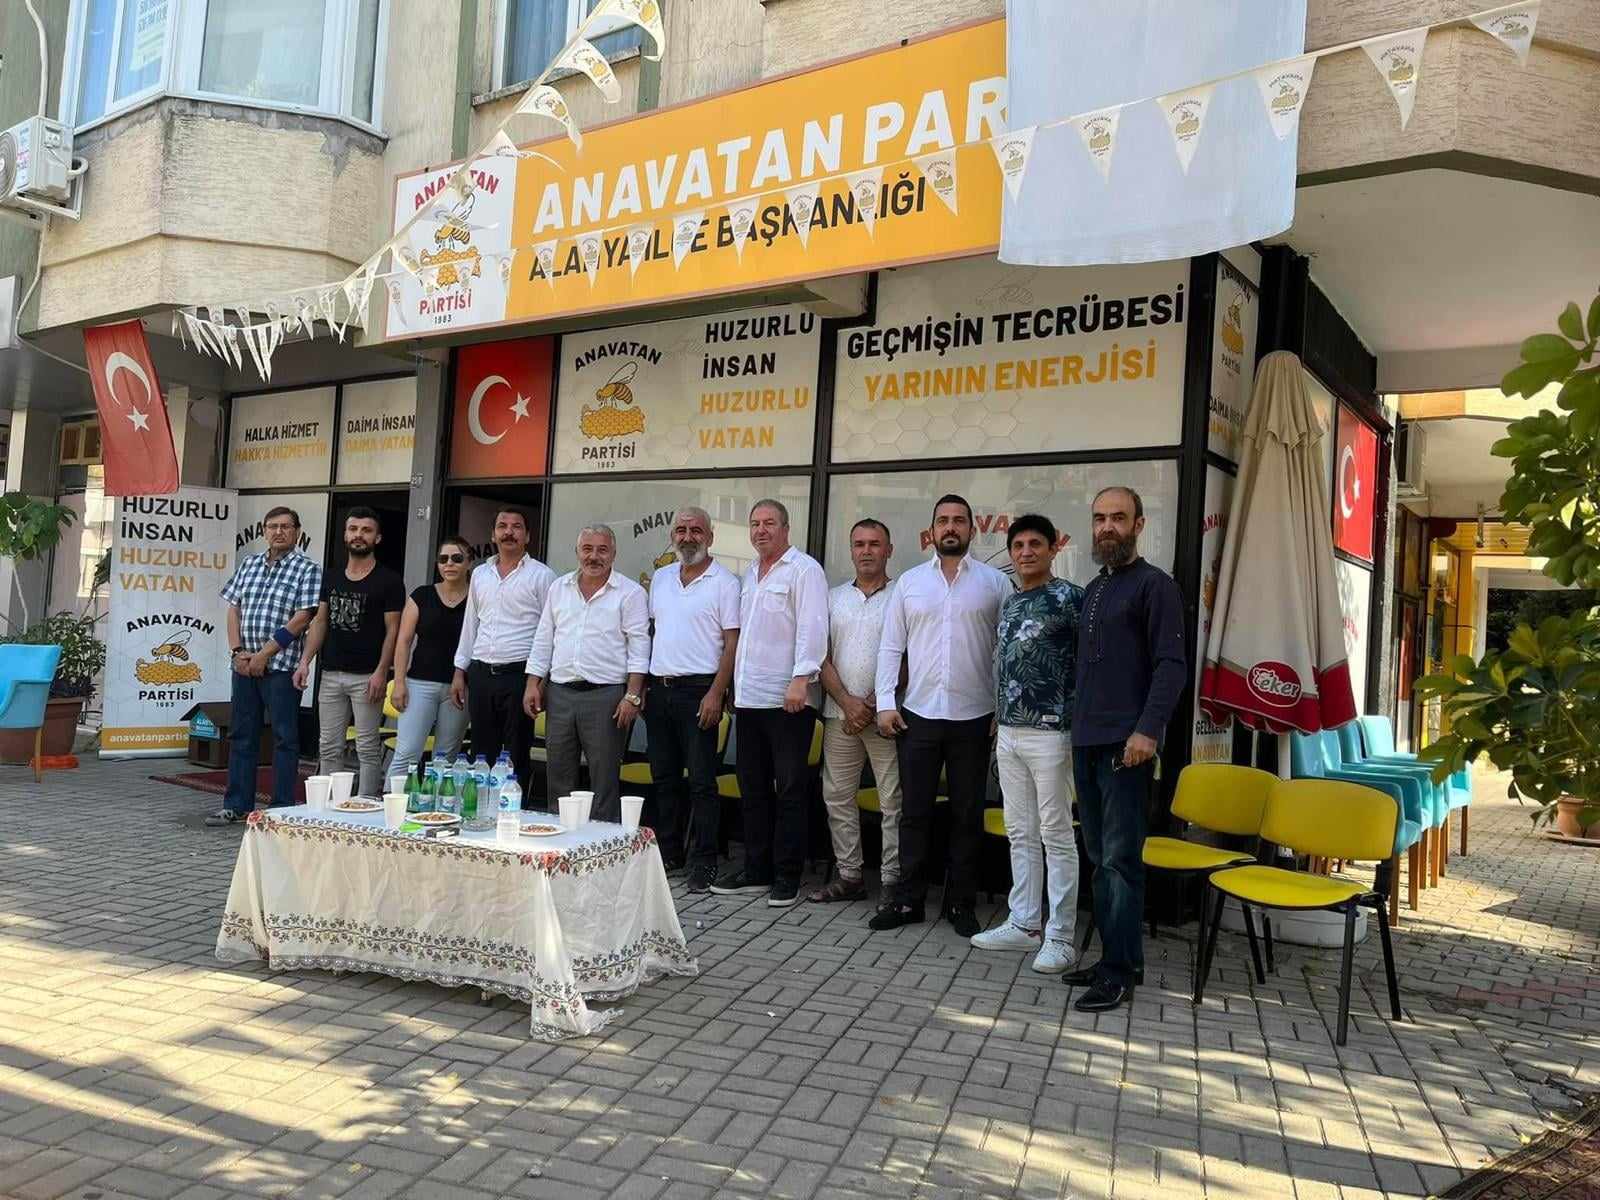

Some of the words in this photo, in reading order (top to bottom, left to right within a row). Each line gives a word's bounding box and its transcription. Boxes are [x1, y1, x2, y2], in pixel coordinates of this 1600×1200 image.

[533, 113, 843, 235] ANAVATAN
[705, 312, 815, 344] HUZURLU
[847, 311, 984, 361] GEÇMİŞİN
[992, 283, 1184, 343] TECRÜBESİ
[574, 341, 663, 372] ANAVATAN
[702, 352, 776, 380] İNSAN
[864, 363, 987, 402] YARININ
[994, 338, 1156, 393] ENERJİSİ
[700, 387, 810, 415] HUZURLU
[245, 426, 279, 442] HALKA
[281, 420, 320, 439] HİZMET
[347, 416, 379, 433] DAİMA
[382, 414, 417, 431] İNSAN
[699, 425, 775, 450] VATAN
[581, 442, 636, 460] PARTİSİ
[122, 496, 229, 521] HUZURLU
[121, 517, 194, 542] İNSAN
[633, 510, 675, 539] ANAV
[120, 546, 227, 570] HUZURLU
[120, 572, 195, 593] VATAN
[126, 614, 215, 635] ANAVATAN
[138, 688, 194, 700] PARTİSİ
